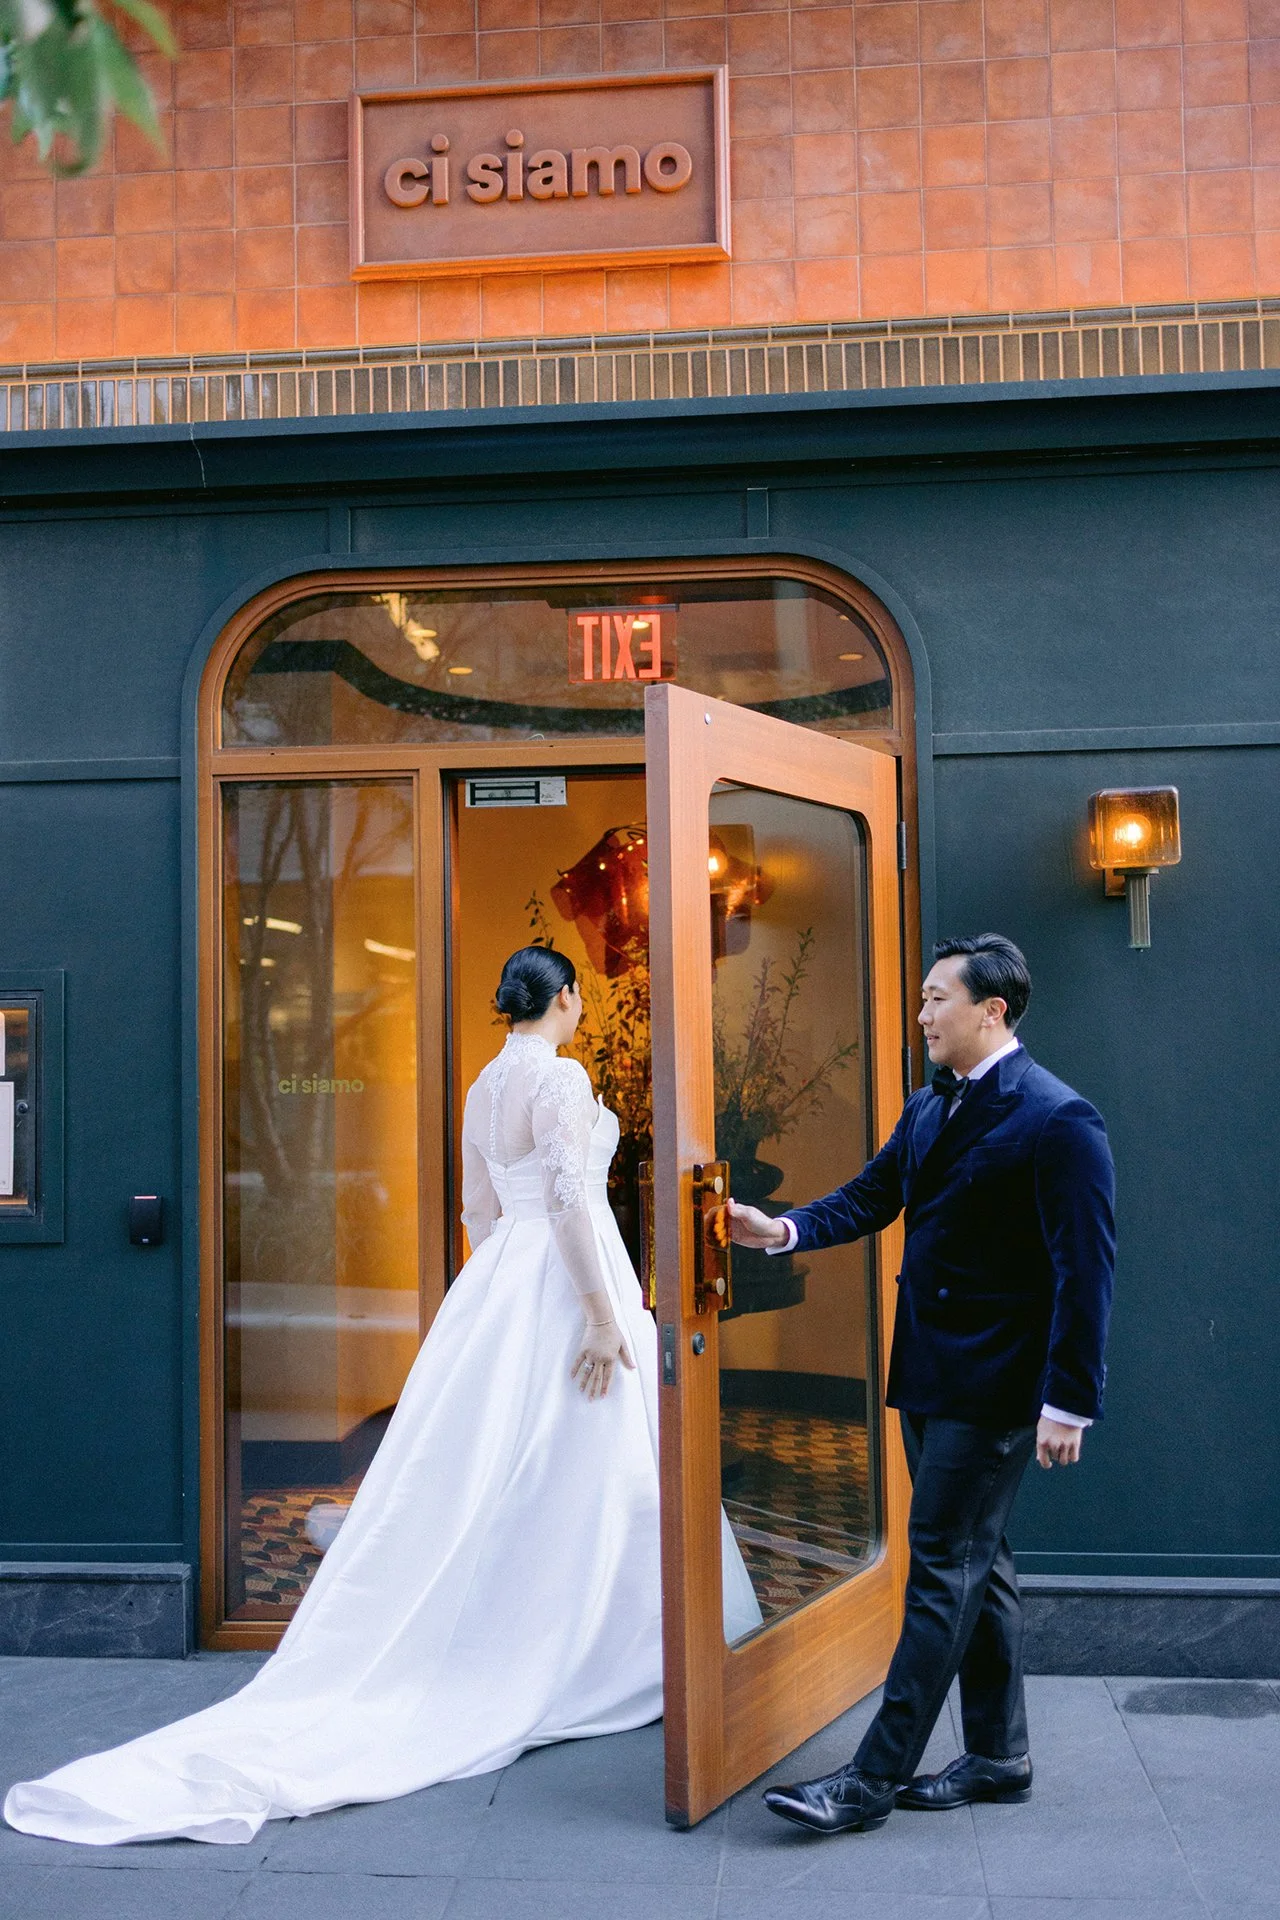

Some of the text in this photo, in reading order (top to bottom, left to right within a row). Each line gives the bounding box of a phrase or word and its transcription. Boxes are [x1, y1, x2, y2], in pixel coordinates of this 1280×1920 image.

[384, 129, 692, 208] ci siamo
[278, 1073, 364, 1094] ci siamo
